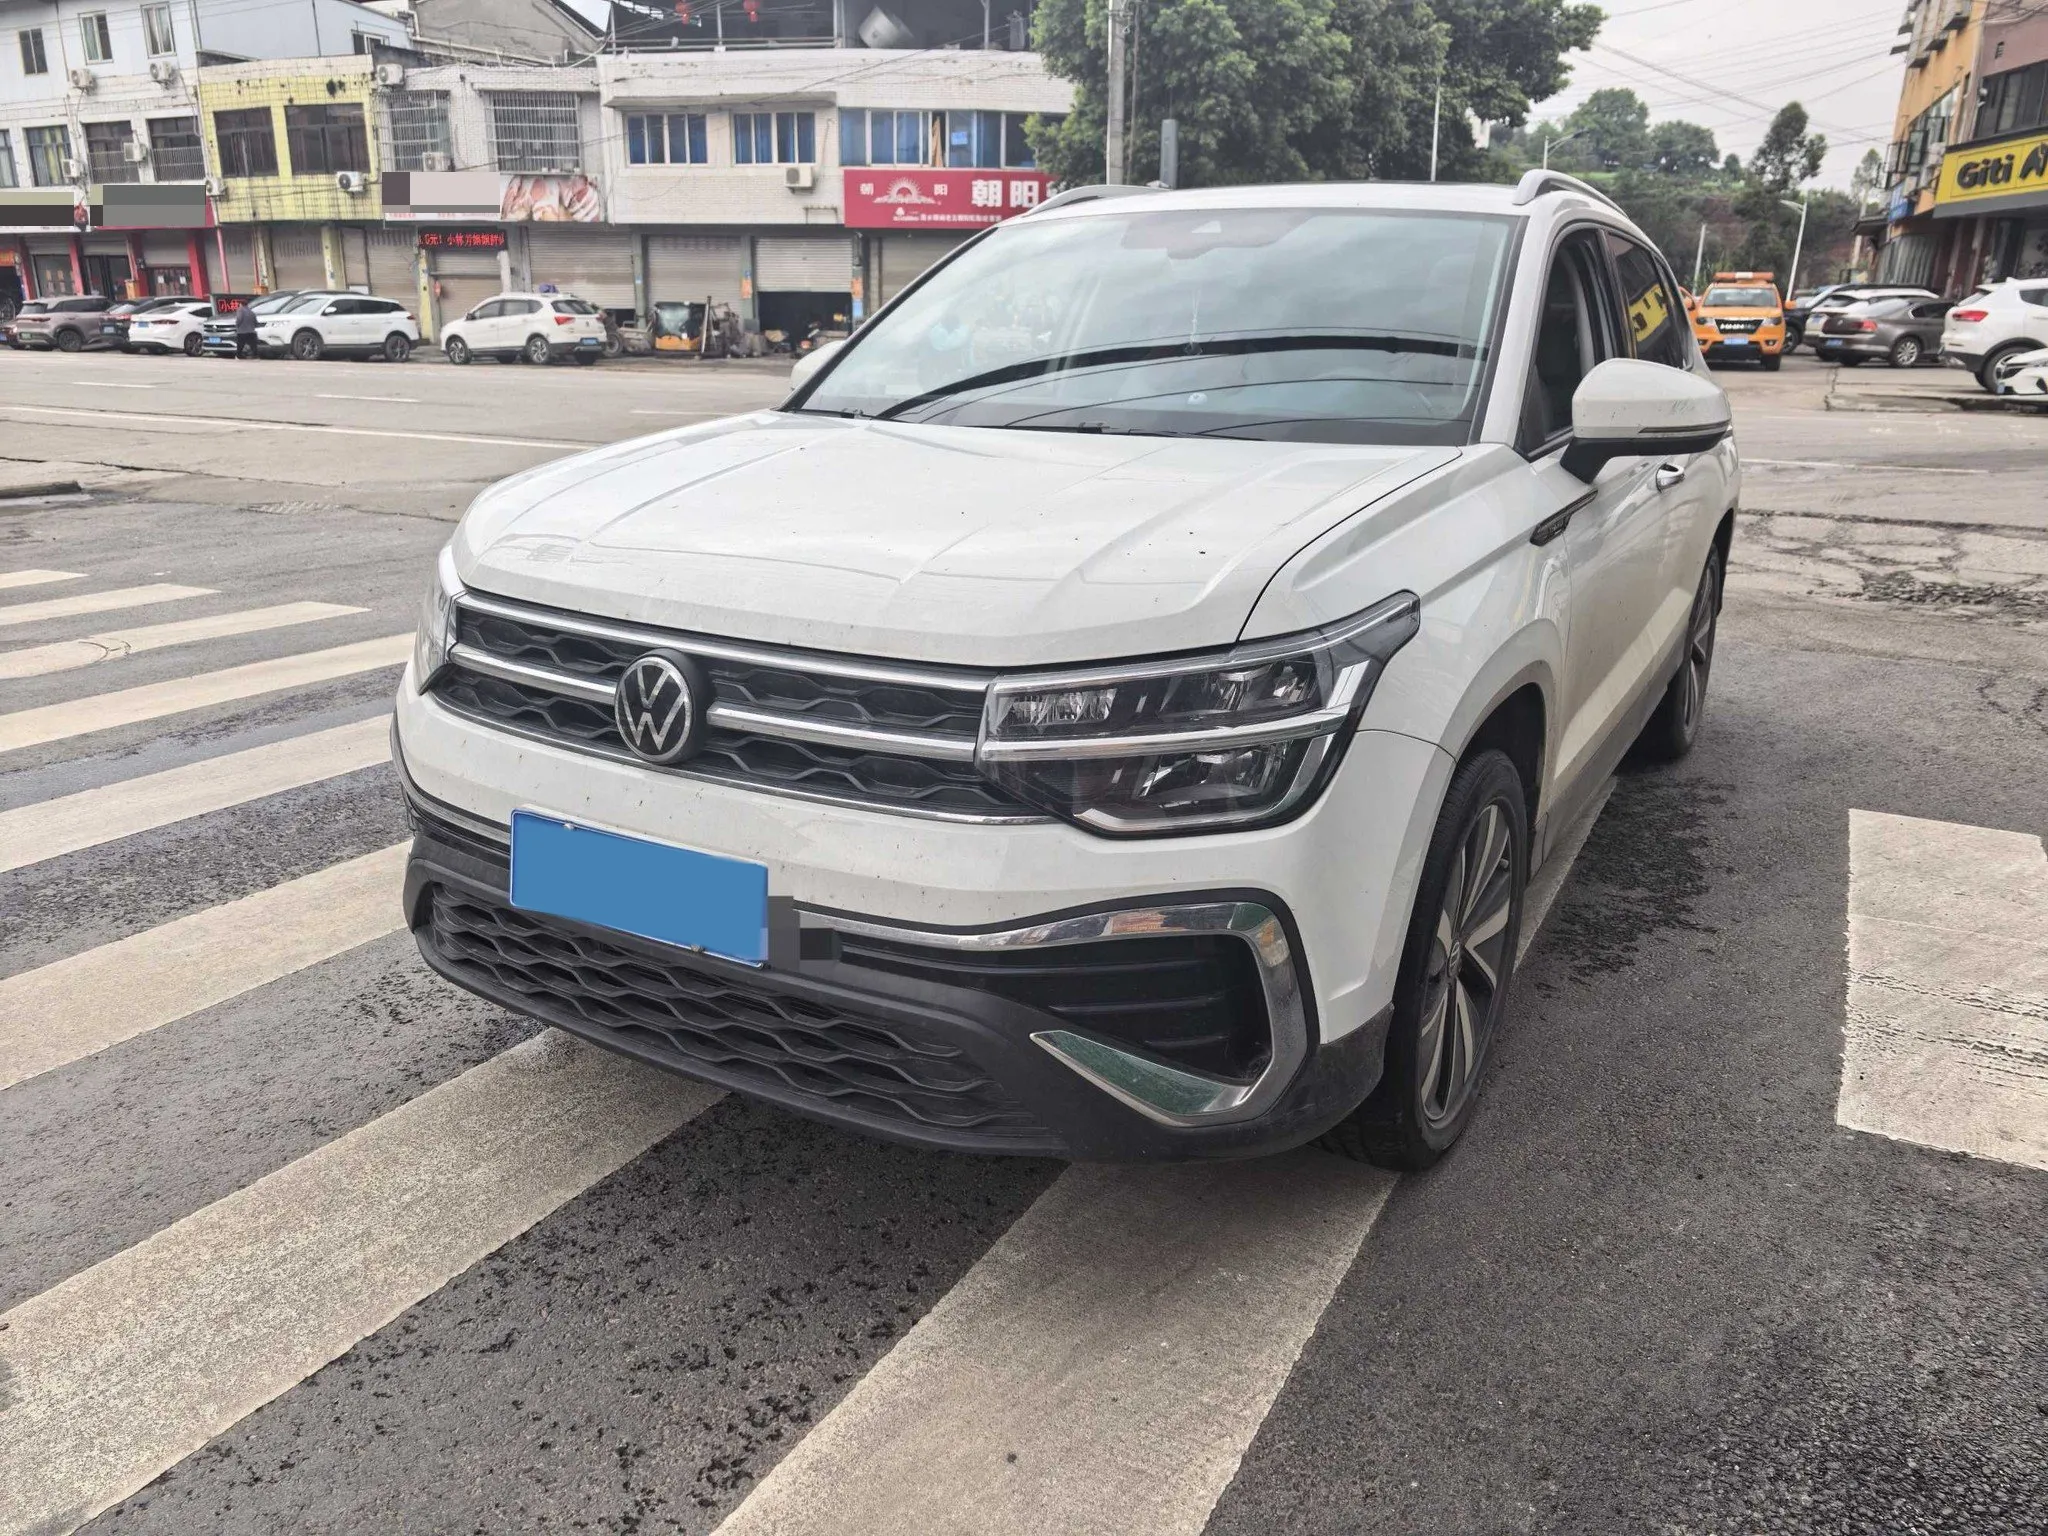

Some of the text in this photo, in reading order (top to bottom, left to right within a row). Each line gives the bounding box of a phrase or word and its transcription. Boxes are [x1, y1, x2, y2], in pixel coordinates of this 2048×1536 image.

[1957, 153, 2016, 189] Giti
[860, 183, 948, 195] 朝 阳
